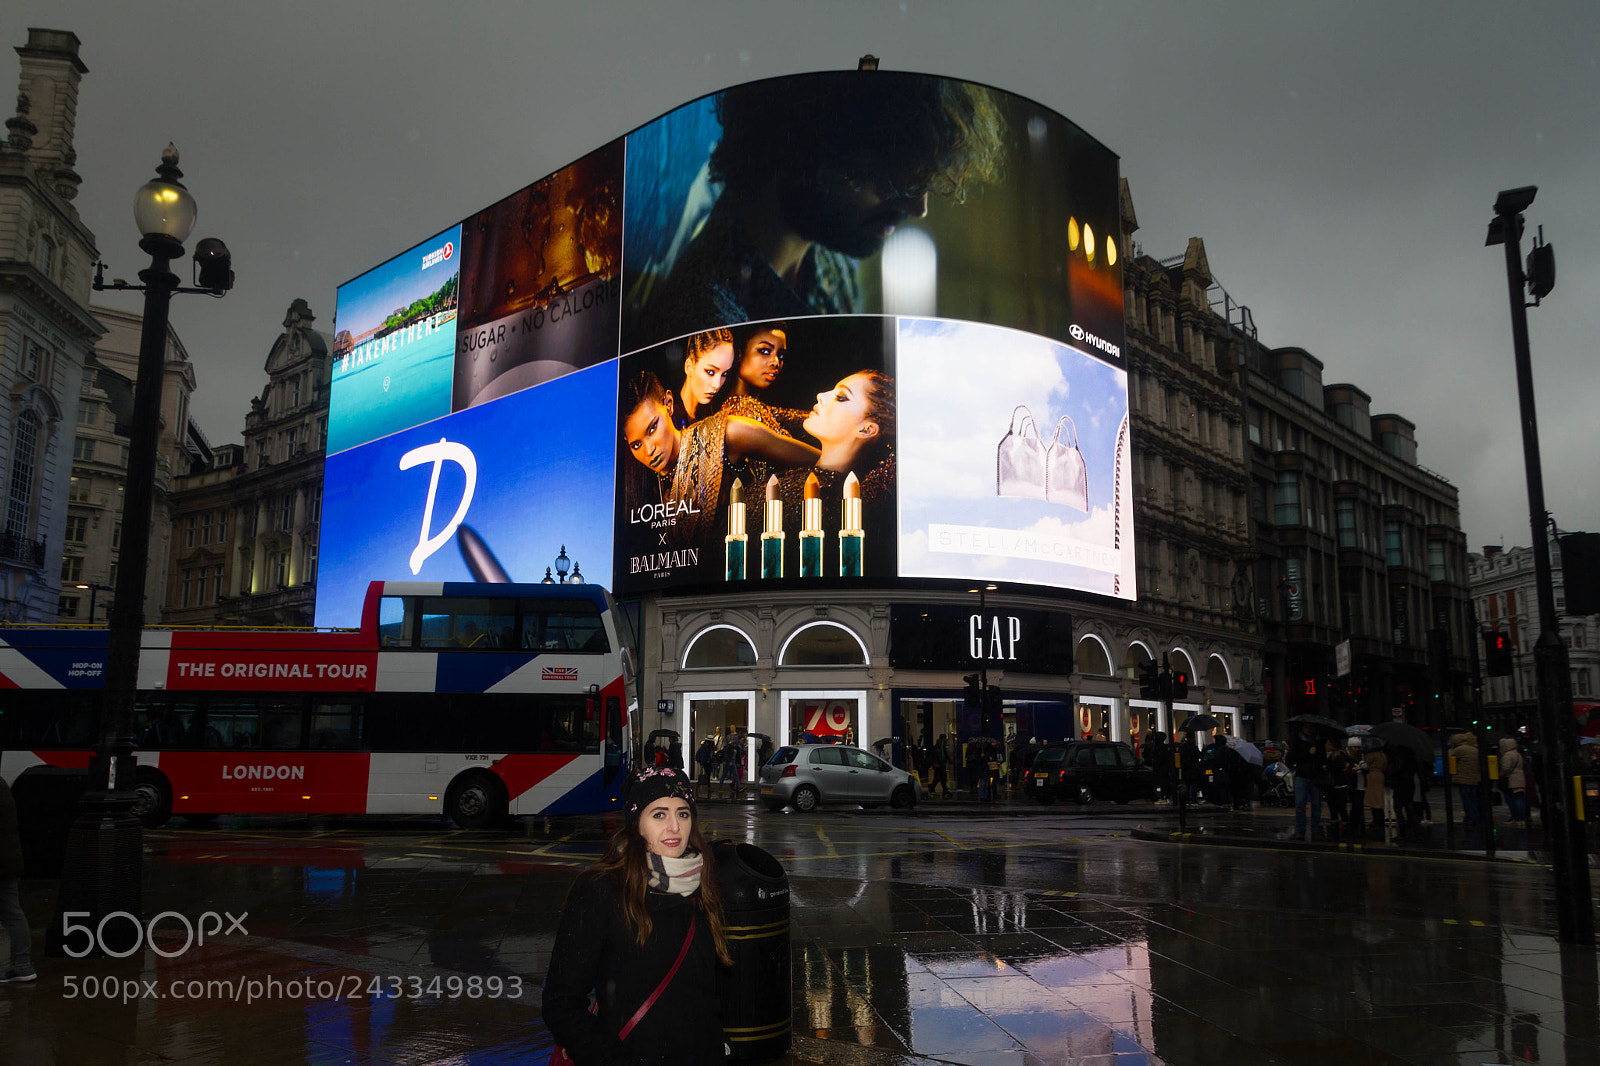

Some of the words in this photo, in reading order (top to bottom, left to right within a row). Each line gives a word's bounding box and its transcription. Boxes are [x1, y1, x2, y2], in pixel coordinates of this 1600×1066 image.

[341, 311, 442, 373] #TAKEMETHERE
[462, 324, 506, 353] SUGAR
[521, 306, 545, 335] NO
[1085, 331, 1120, 358] HYUNDAI
[651, 517, 677, 529] PARIS
[630, 548, 699, 574] BALMAIN
[653, 570, 671, 579] PARIS
[969, 614, 1021, 661] GAP
[68, 669, 102, 677] HOP-OFF
[177, 662, 216, 677] THE
[220, 662, 313, 678] ORIGINAL
[315, 664, 368, 679] TOUR
[805, 700, 851, 731] 70
[222, 765, 305, 780] LONDON
